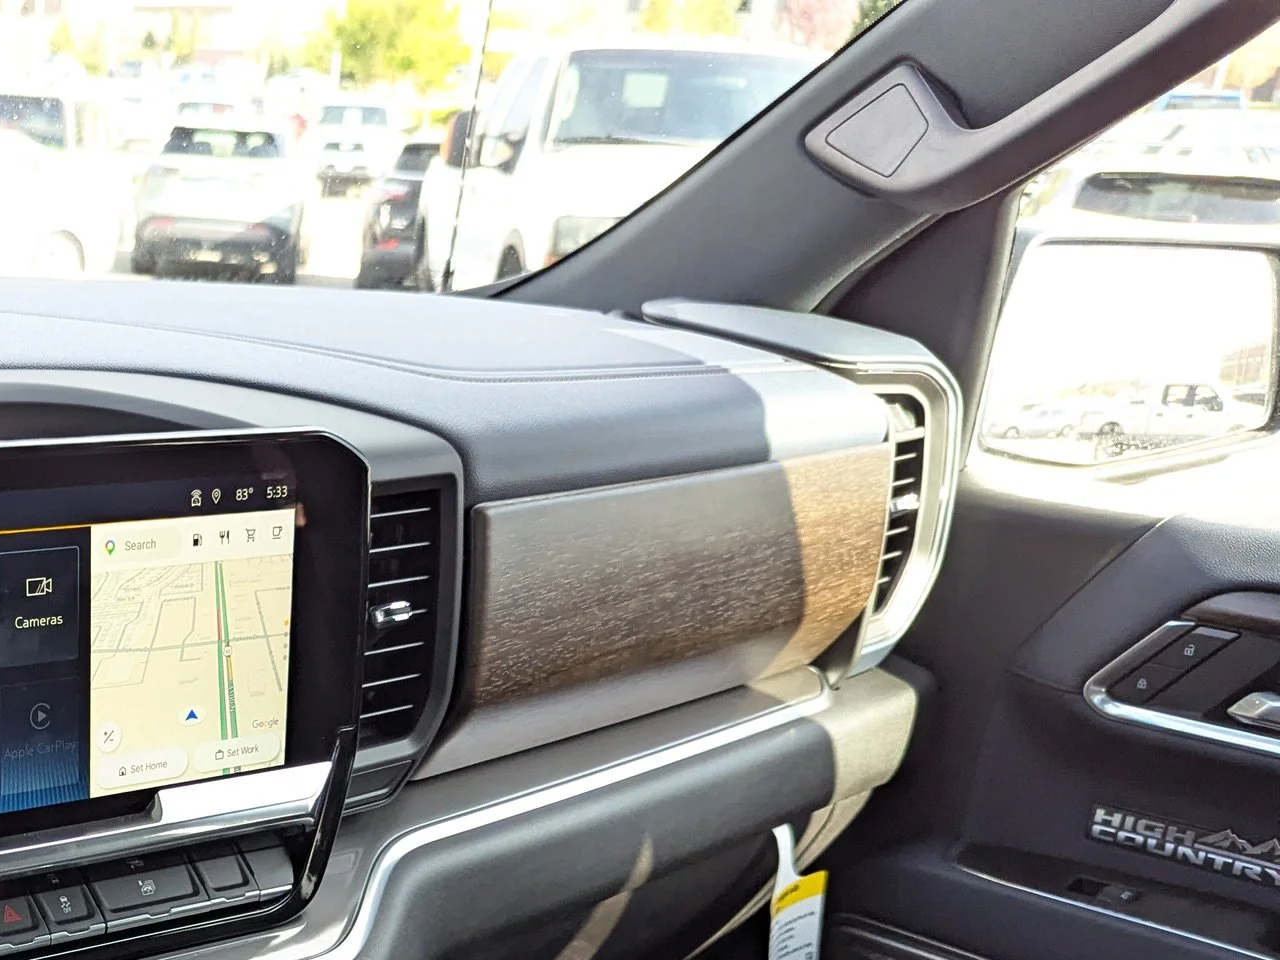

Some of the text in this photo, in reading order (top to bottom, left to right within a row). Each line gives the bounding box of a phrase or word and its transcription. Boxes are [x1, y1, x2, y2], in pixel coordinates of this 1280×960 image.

[266, 486, 288, 499] 5:33
[124, 539, 157, 552] Search
[14, 614, 63, 629] Cameras
[4, 740, 77, 760] Apple CarPlay
[226, 743, 260, 758] Set Work
[130, 760, 168, 774] Set Home
[1093, 808, 1197, 846] HIGH
[1091, 824, 1280, 887] COUNTRY
